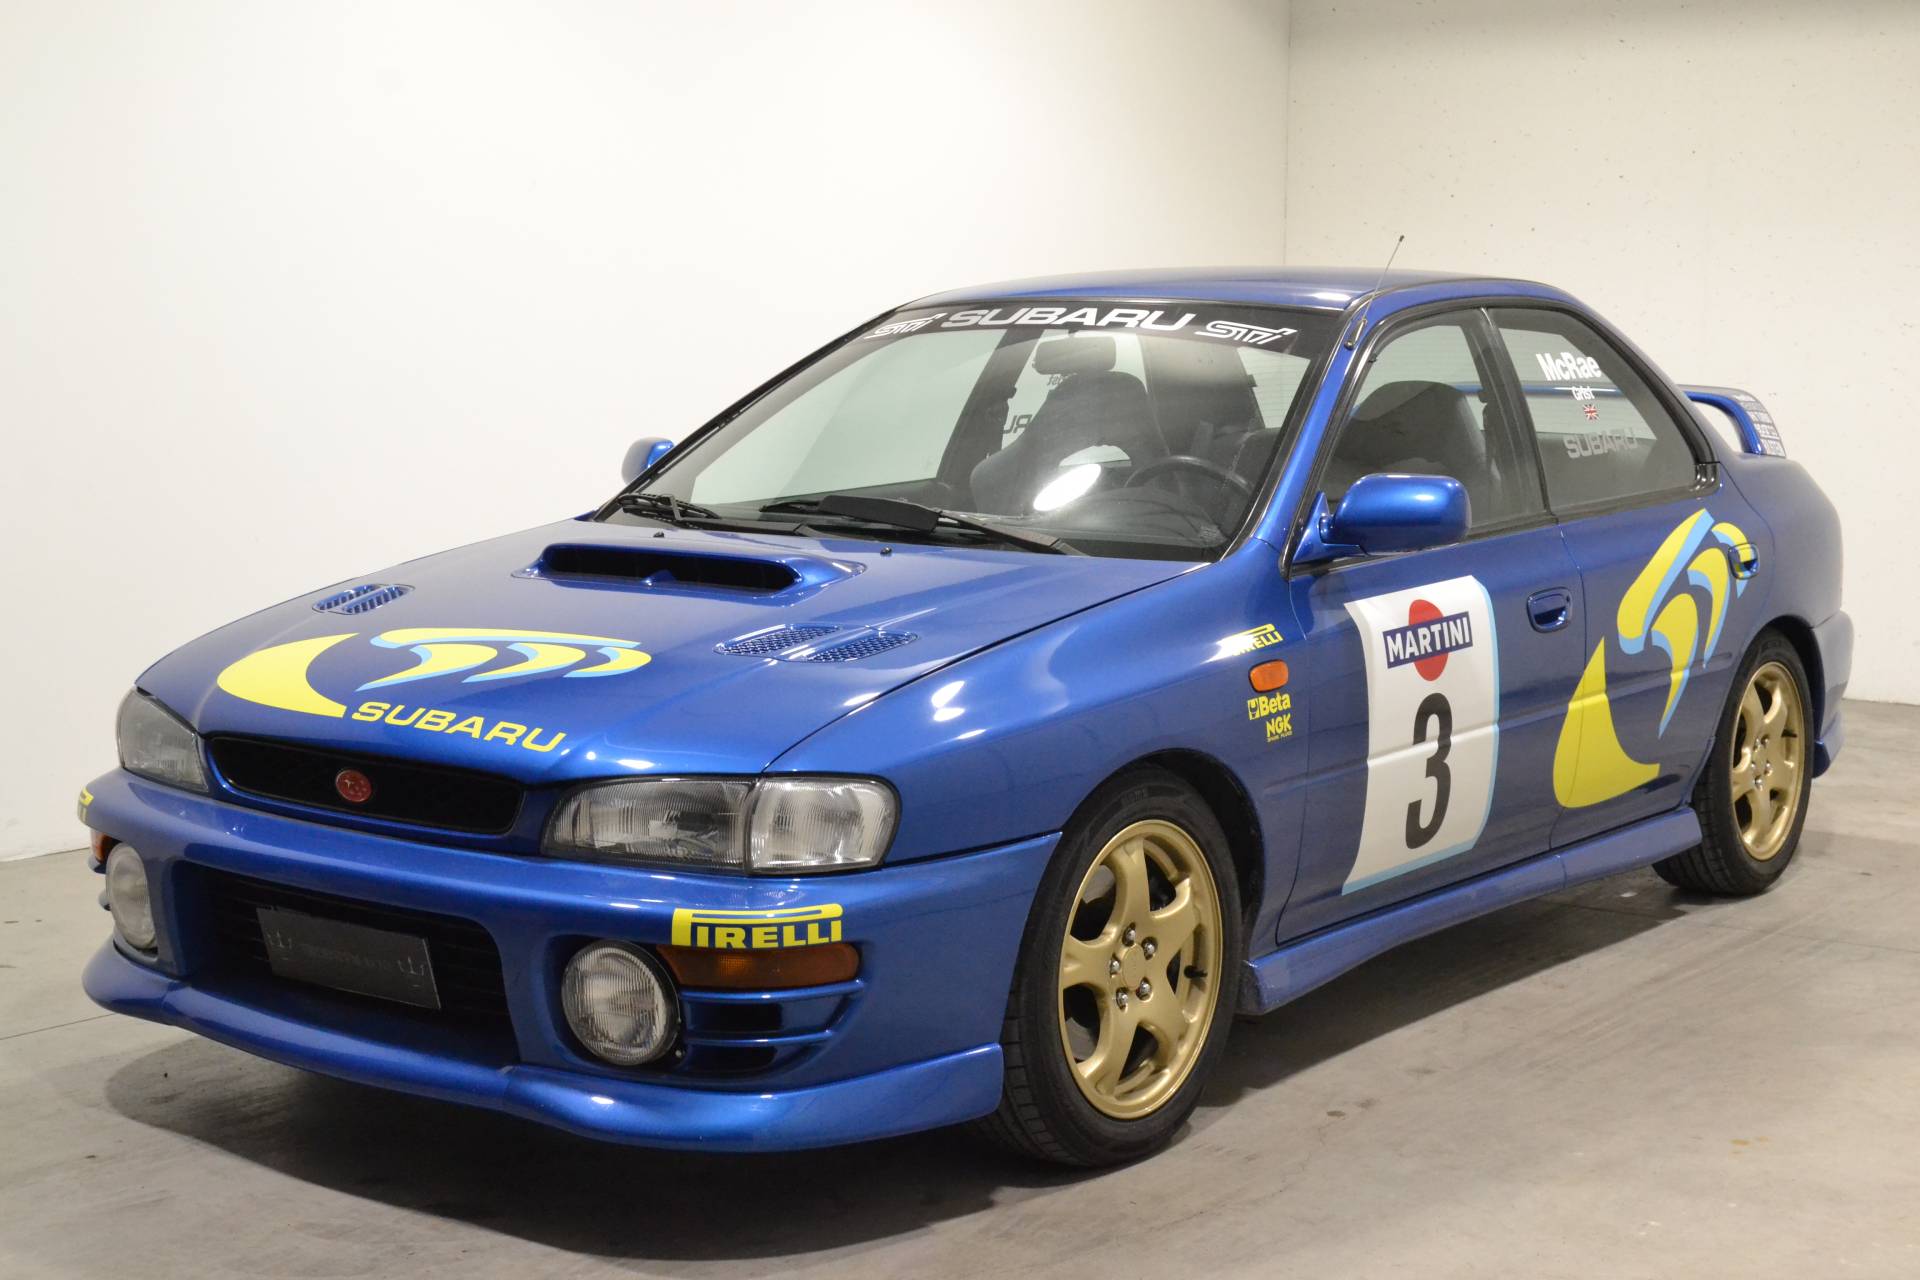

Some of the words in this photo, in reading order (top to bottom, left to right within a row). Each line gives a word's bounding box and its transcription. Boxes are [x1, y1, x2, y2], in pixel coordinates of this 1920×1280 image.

[940, 307, 1196, 331] SUBARU
[1536, 352, 1602, 381] McRae
[1563, 428, 1639, 459] SUBARU
[1386, 616, 1470, 663] MARTINI
[1258, 692, 1292, 717] Beta
[351, 701, 567, 753] SUBARU
[1266, 713, 1292, 737] NGK
[1405, 692, 1453, 850] 3
[671, 903, 843, 949] PIRELLI
